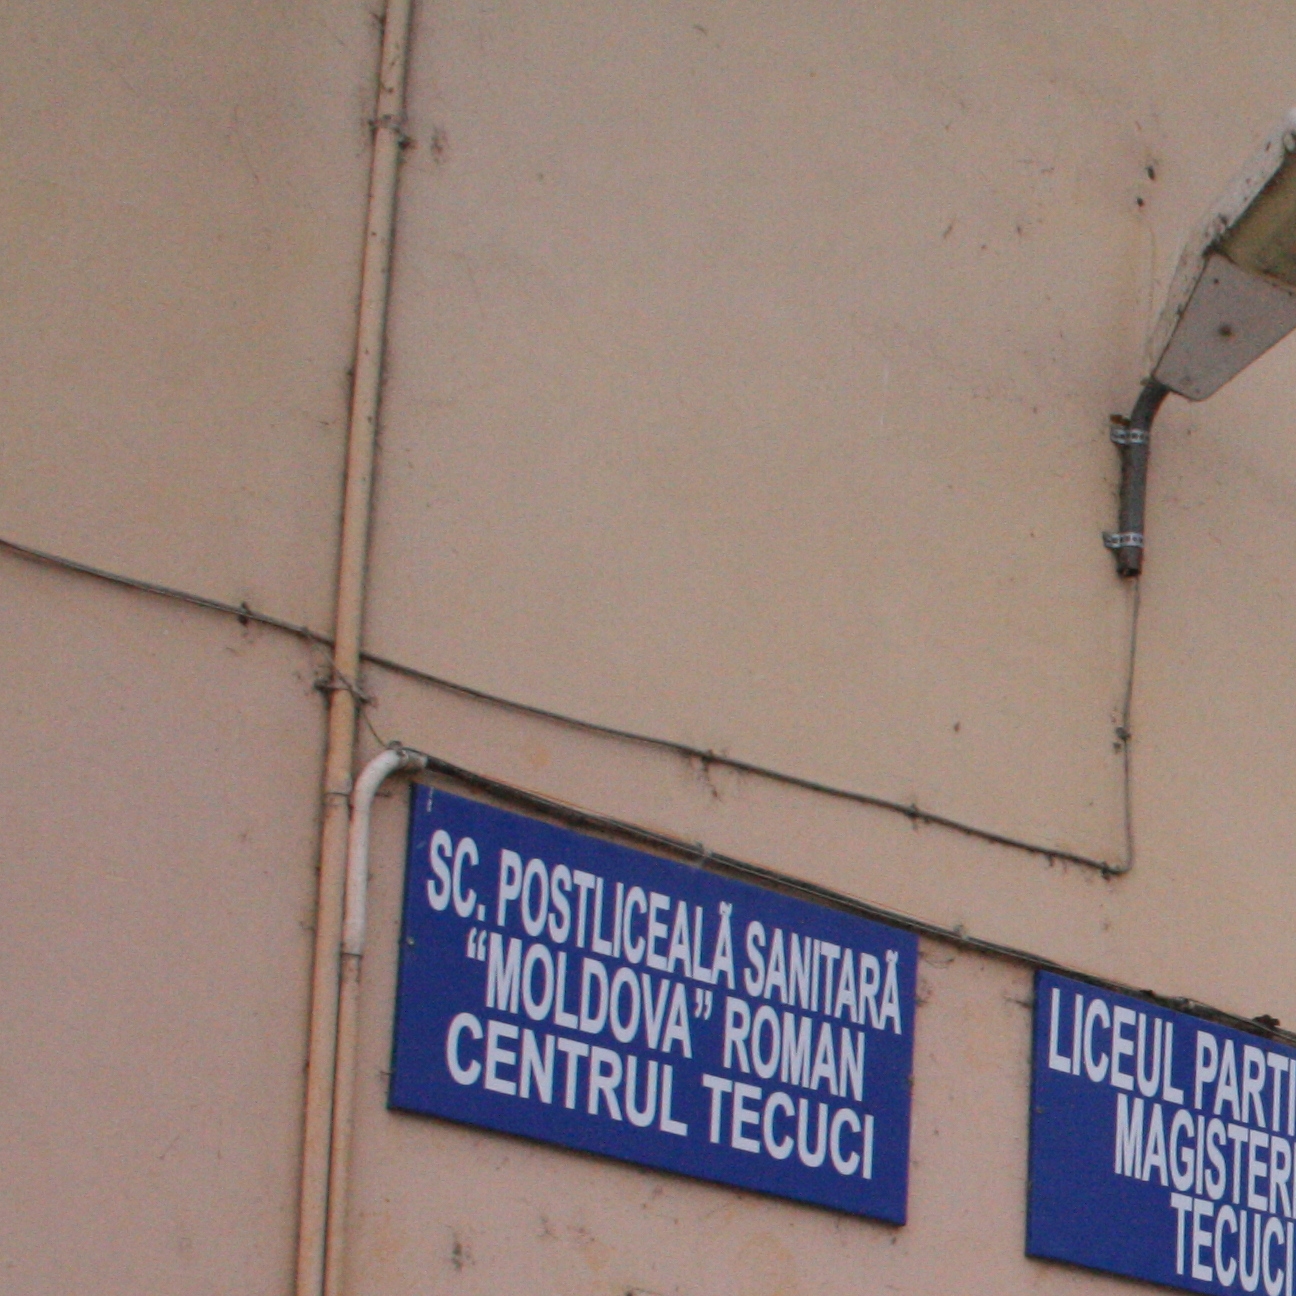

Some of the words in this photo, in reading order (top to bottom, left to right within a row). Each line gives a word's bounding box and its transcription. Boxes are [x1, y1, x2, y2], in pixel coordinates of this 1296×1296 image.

[427, 830, 485, 921] SC.
[498, 848, 734, 989] POSTLICEALĂ
[744, 921, 901, 1034] SANITARĂ
[467, 928, 712, 1058] “MOLDOVA”
[724, 997, 865, 1101] ROMAN
[447, 1013, 688, 1136] CENTRUL
[703, 1074, 873, 1179] TECUCI
[1048, 988, 1184, 1105] LICEUL
